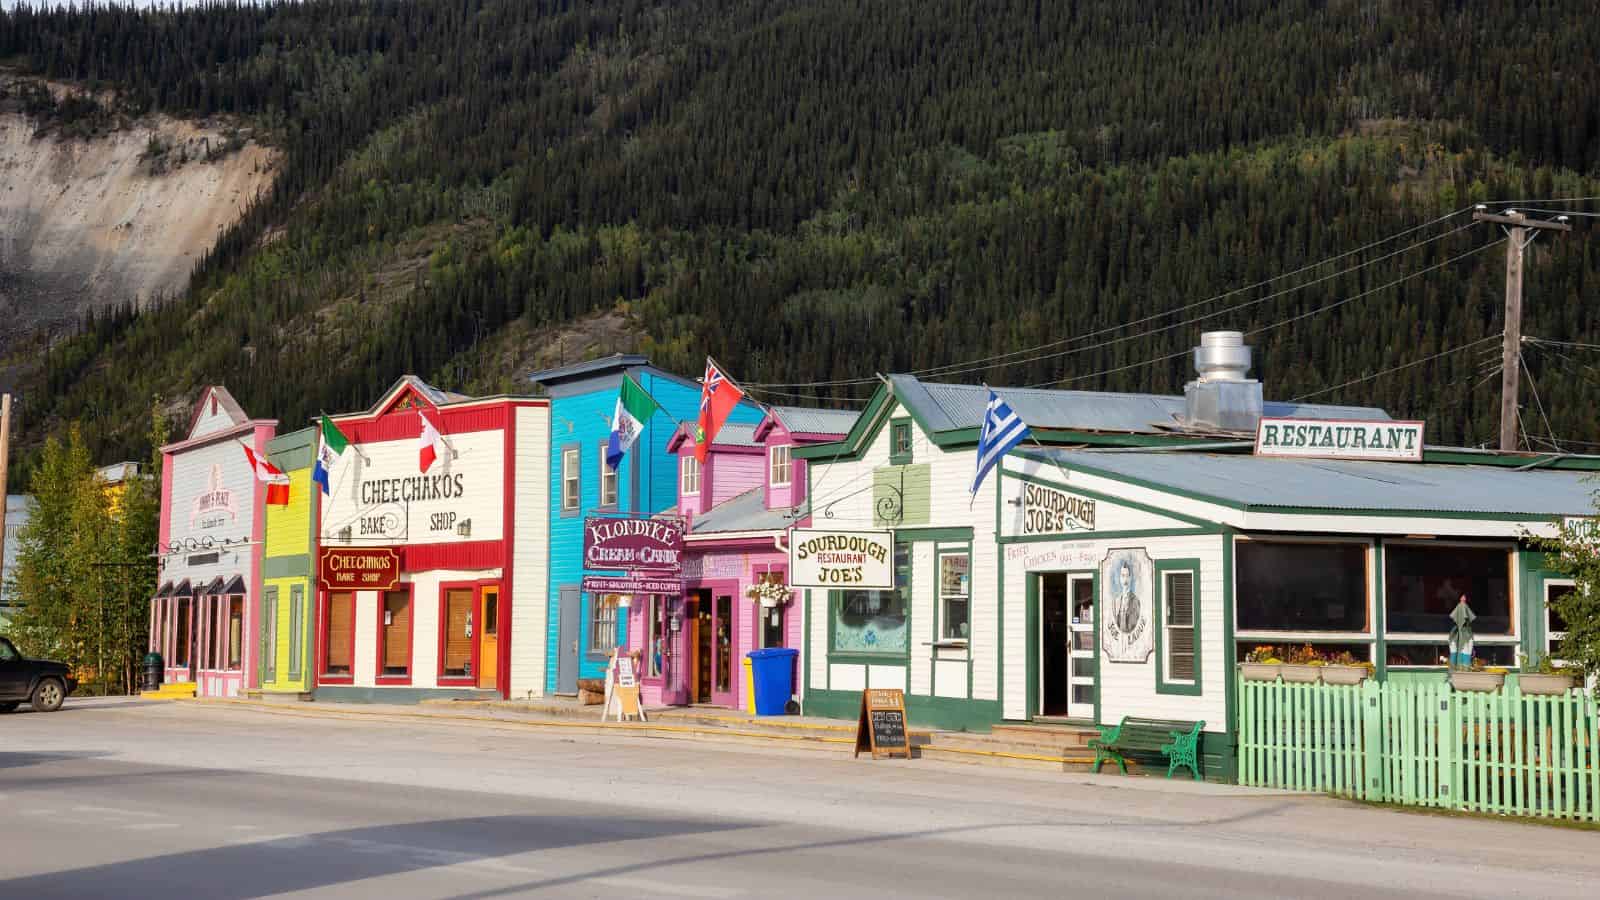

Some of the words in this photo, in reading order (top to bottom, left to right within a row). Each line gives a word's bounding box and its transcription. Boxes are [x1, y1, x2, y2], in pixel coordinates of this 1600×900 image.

[1262, 424, 1417, 450] RESTAURANT
[361, 473, 464, 505] CHEECHAKOS
[1026, 484, 1095, 525] SOURDOUGH
[360, 515, 386, 535] BAKE
[430, 511, 457, 532] SHOP
[590, 519, 676, 546] KLONDYKE
[1026, 509, 1064, 533] JOE'S
[588, 545, 635, 562] CREAM
[640, 546, 680, 564] CANDY
[797, 535, 888, 564] SOURDOUGH
[817, 552, 867, 564] RESTAURANT
[329, 554, 391, 571] CHEECHAKOS
[818, 566, 863, 583] JOE'S
[361, 572, 381, 582] SHOP
